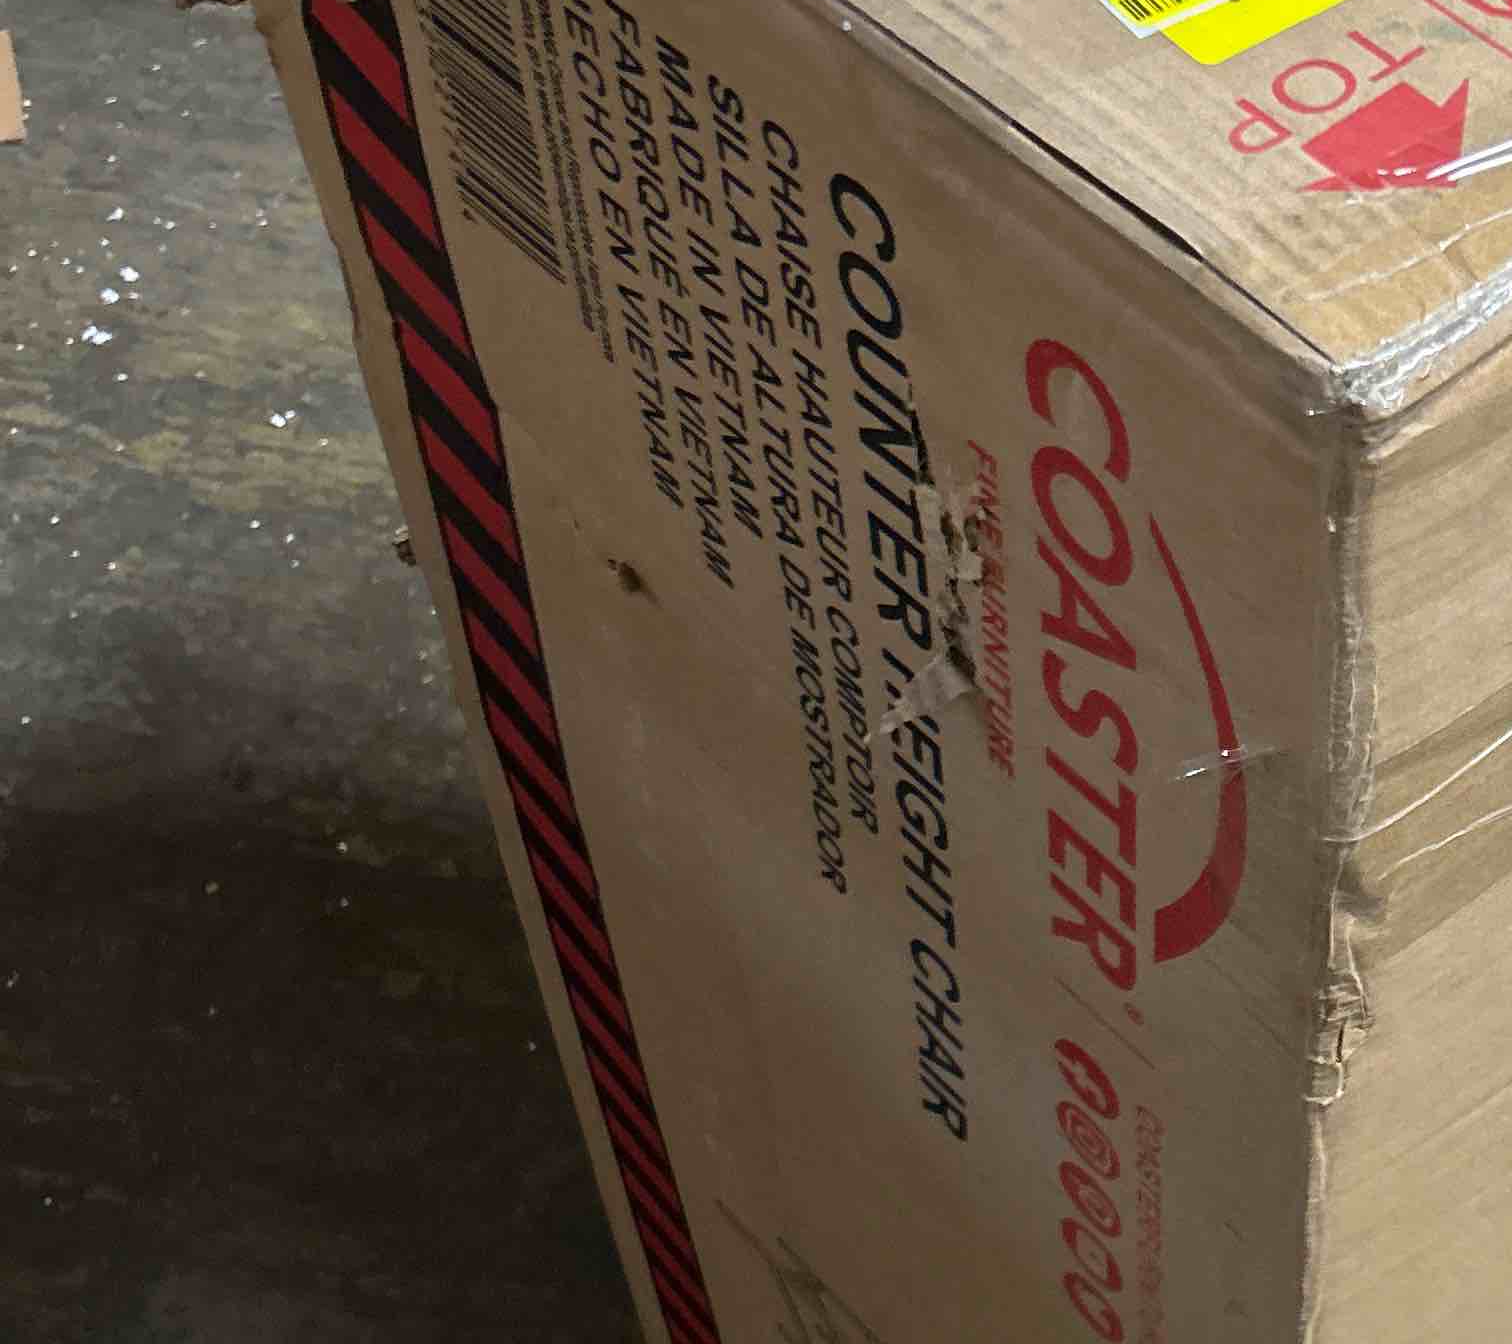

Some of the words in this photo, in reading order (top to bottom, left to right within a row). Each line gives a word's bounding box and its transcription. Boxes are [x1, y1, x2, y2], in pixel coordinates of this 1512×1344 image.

[656, 35, 713, 225] MADE
[708, 74, 761, 247] SILLA
[1229, 29, 1427, 155] TOP
[599, 189, 639, 274] EN
[687, 228, 724, 296] IN
[736, 258, 776, 346] DE
[616, 284, 684, 508] VIETNAM
[658, 299, 697, 379] EN
[699, 305, 763, 539] VIETNAM
[674, 387, 733, 588] VIETNAM
[747, 343, 804, 548] ALTURA
[762, 120, 822, 349] CHAISE
[792, 349, 852, 602] HAUTEUR
[826, 606, 878, 834] COMPTOIR
[779, 555, 816, 630] DE
[829, 174, 932, 650] COUNTER
[910, 939, 967, 1141] CHAIR
[1025, 339, 1138, 990] COASTER
[791, 627, 846, 894] MOSTRADOR
